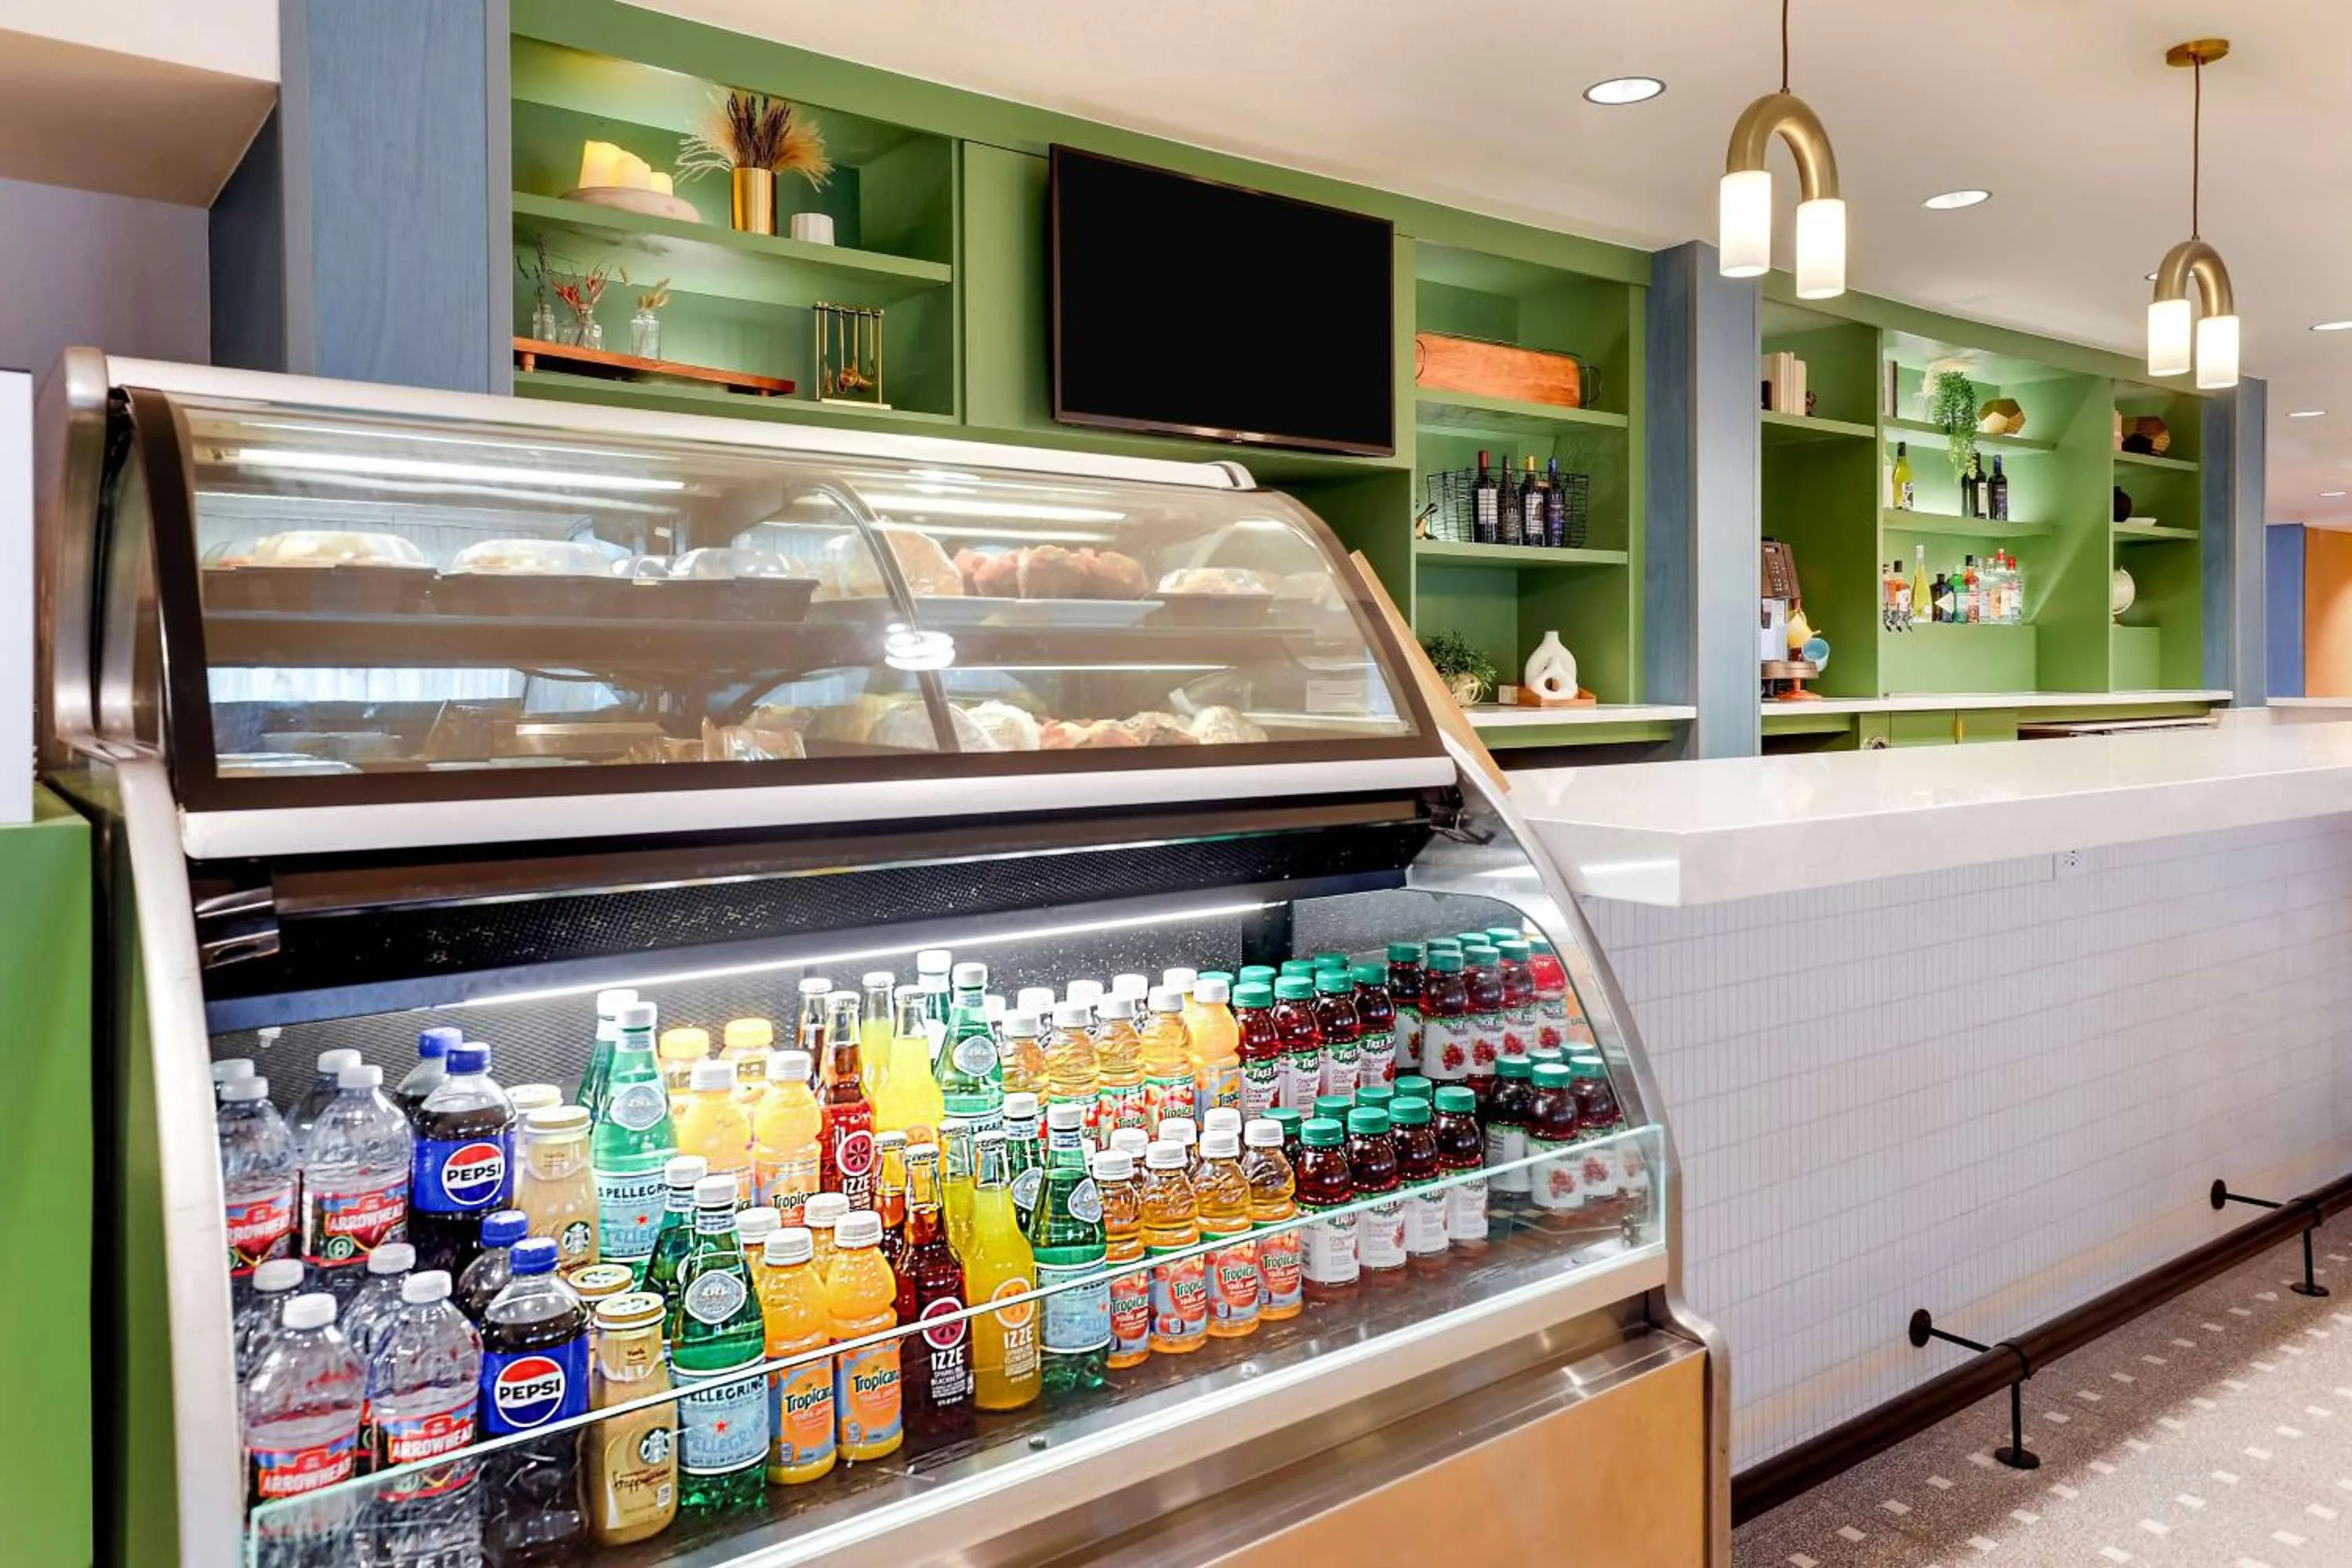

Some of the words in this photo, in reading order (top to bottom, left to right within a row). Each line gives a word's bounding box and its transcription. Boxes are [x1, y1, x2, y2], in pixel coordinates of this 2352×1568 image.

[447, 1163, 501, 1182] PEPSI
[843, 1173, 871, 1194] IZZE
[772, 1190, 820, 1209] Tropic
[1004, 1323, 1034, 1349] IZZE
[931, 1345, 966, 1371] IZZE
[499, 1377, 561, 1400] PEPSI
[853, 1369, 899, 1392] Tropica
[786, 1385, 834, 1413] Tropica
